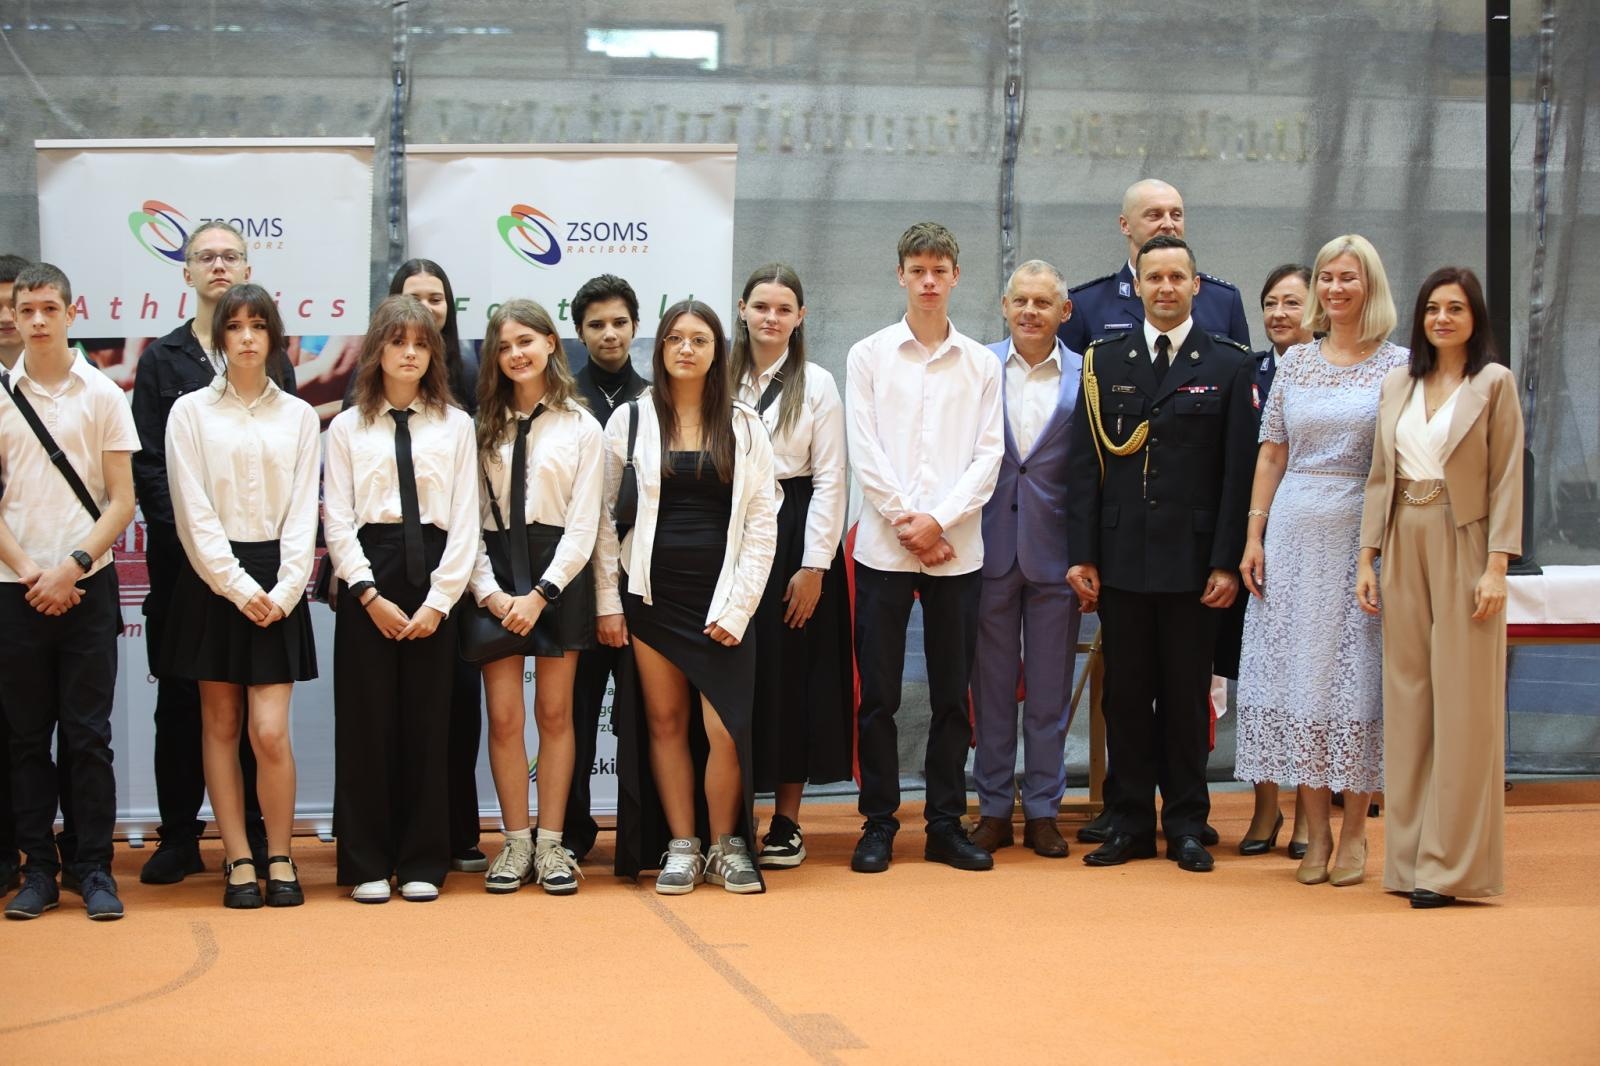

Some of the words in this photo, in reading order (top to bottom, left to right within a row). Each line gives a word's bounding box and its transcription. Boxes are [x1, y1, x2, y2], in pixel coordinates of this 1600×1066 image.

[199, 217, 283, 238] OMS
[566, 222, 648, 241] ZSOMS
[74, 292, 345, 320] Athlcs
